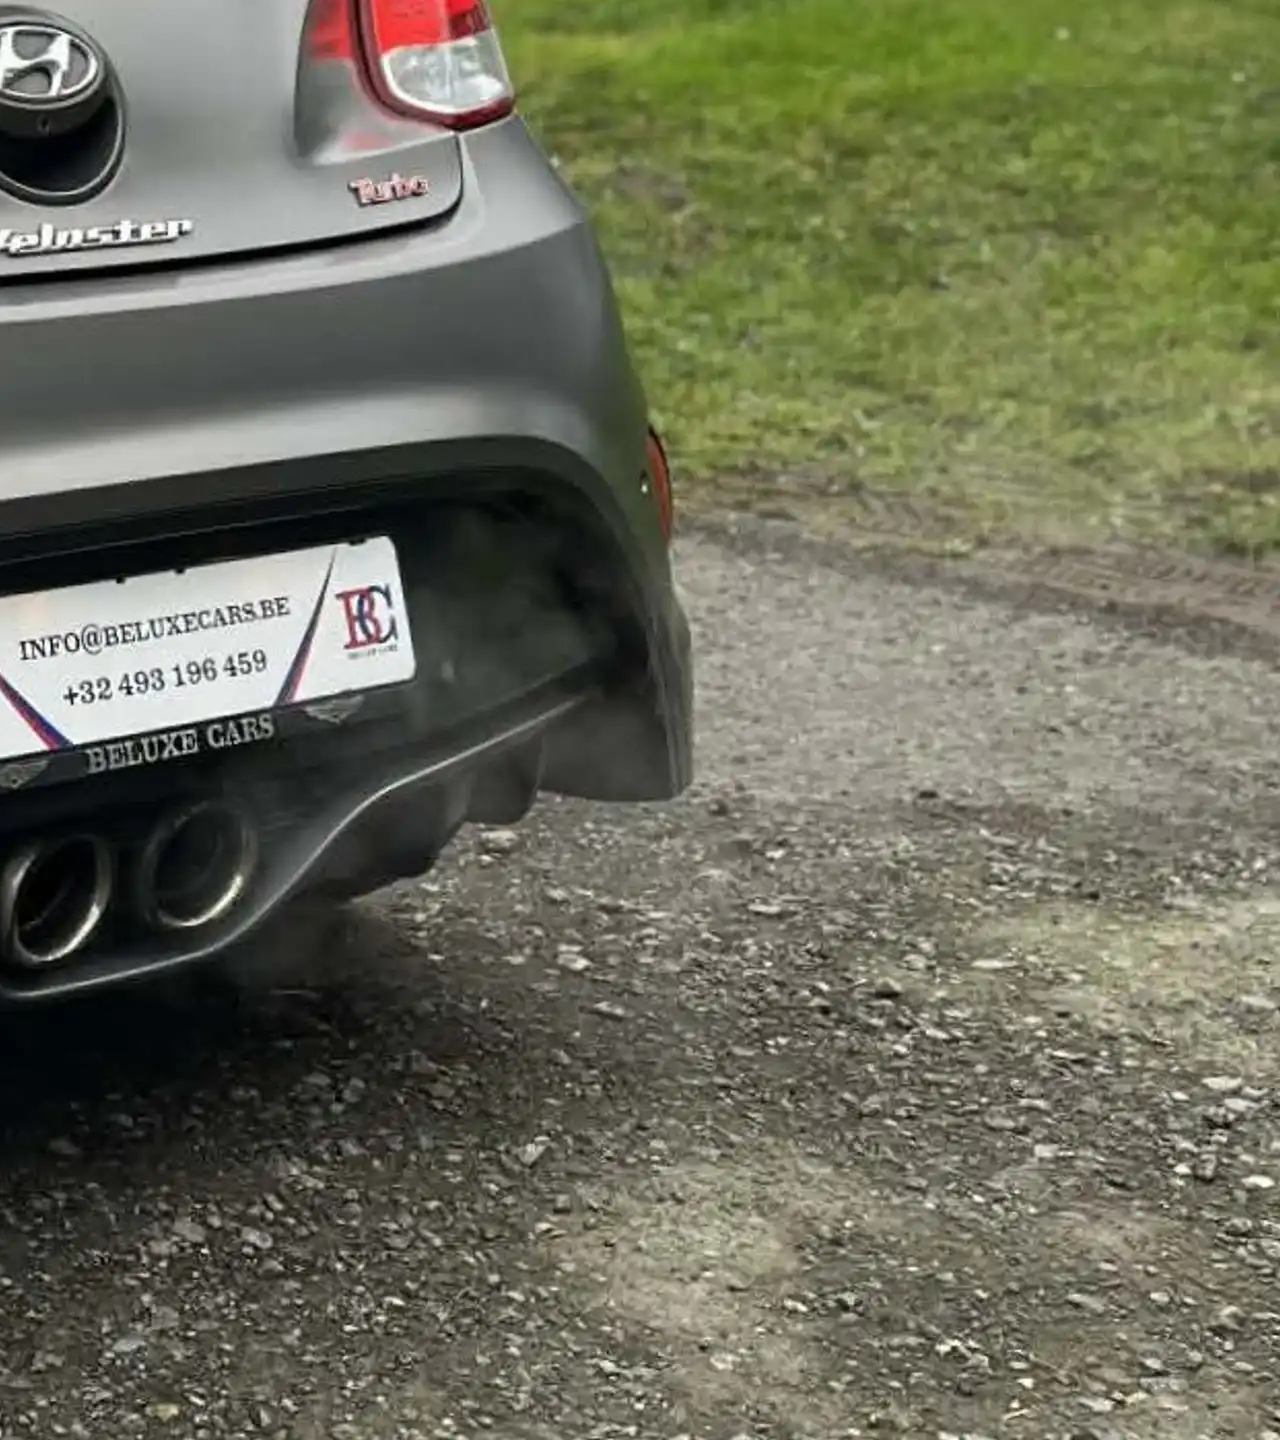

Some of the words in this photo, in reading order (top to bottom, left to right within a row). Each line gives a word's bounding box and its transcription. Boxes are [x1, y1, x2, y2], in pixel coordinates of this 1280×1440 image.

[19, 596, 291, 661] INFO@BELUXECARS.BE
[63, 677, 113, 706] +32
[118, 667, 165, 697] 493
[172, 658, 218, 688] 196
[223, 649, 269, 679] 459
[86, 728, 200, 775] BELUXE
[205, 713, 276, 749] CARS
